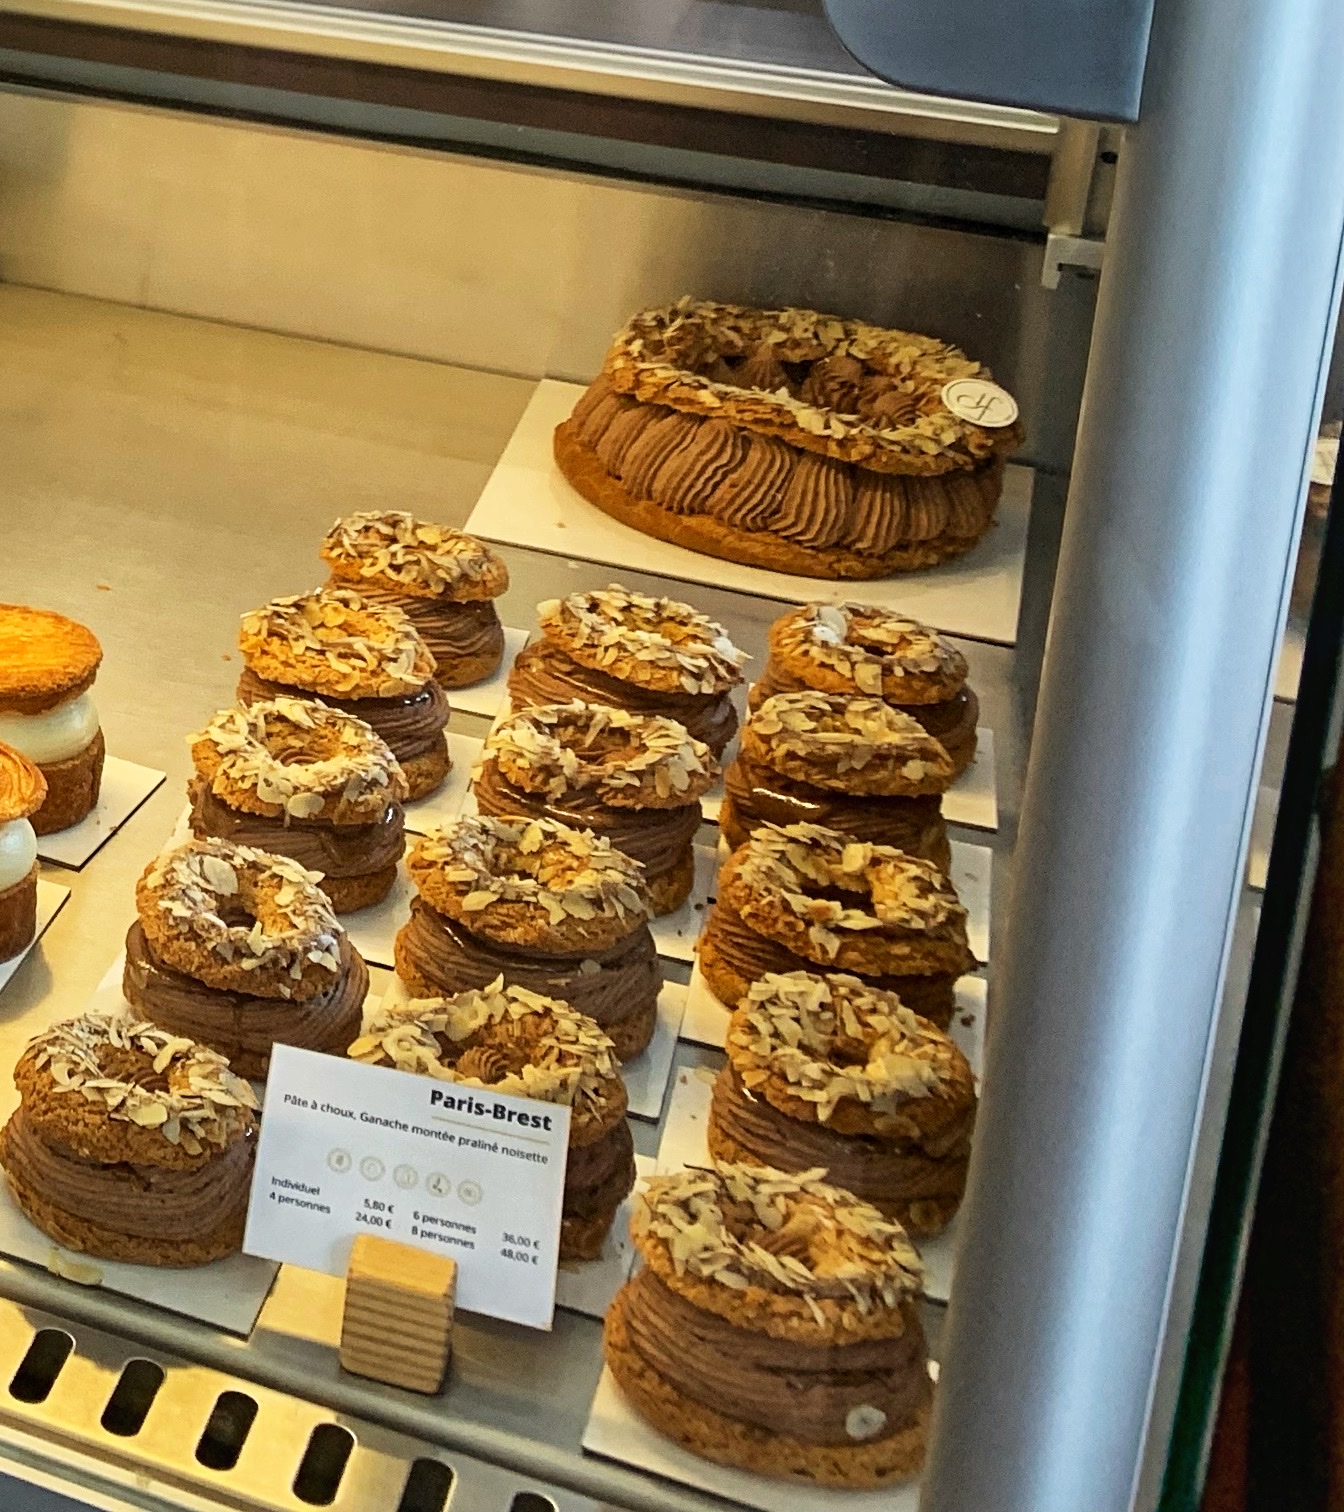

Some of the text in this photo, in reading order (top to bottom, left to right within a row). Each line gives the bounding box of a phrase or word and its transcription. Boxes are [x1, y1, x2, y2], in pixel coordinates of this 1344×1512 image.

[284, 1094, 548, 1164] Pâte à choux, Ganache montée praliné noisette
[431, 1089, 552, 1131] Paris-Brest
[269, 1192, 538, 1265] 4 personnes 24,00 € 8 personnes 48,00 €
[271, 1176, 320, 1196] Individuel
[364, 1199, 385, 1212] 5,80
[388, 1205, 394, 1214] €
[413, 1211, 420, 1220] 6
[422, 1213, 477, 1234] personnes
[533, 1240, 540, 1250] €
